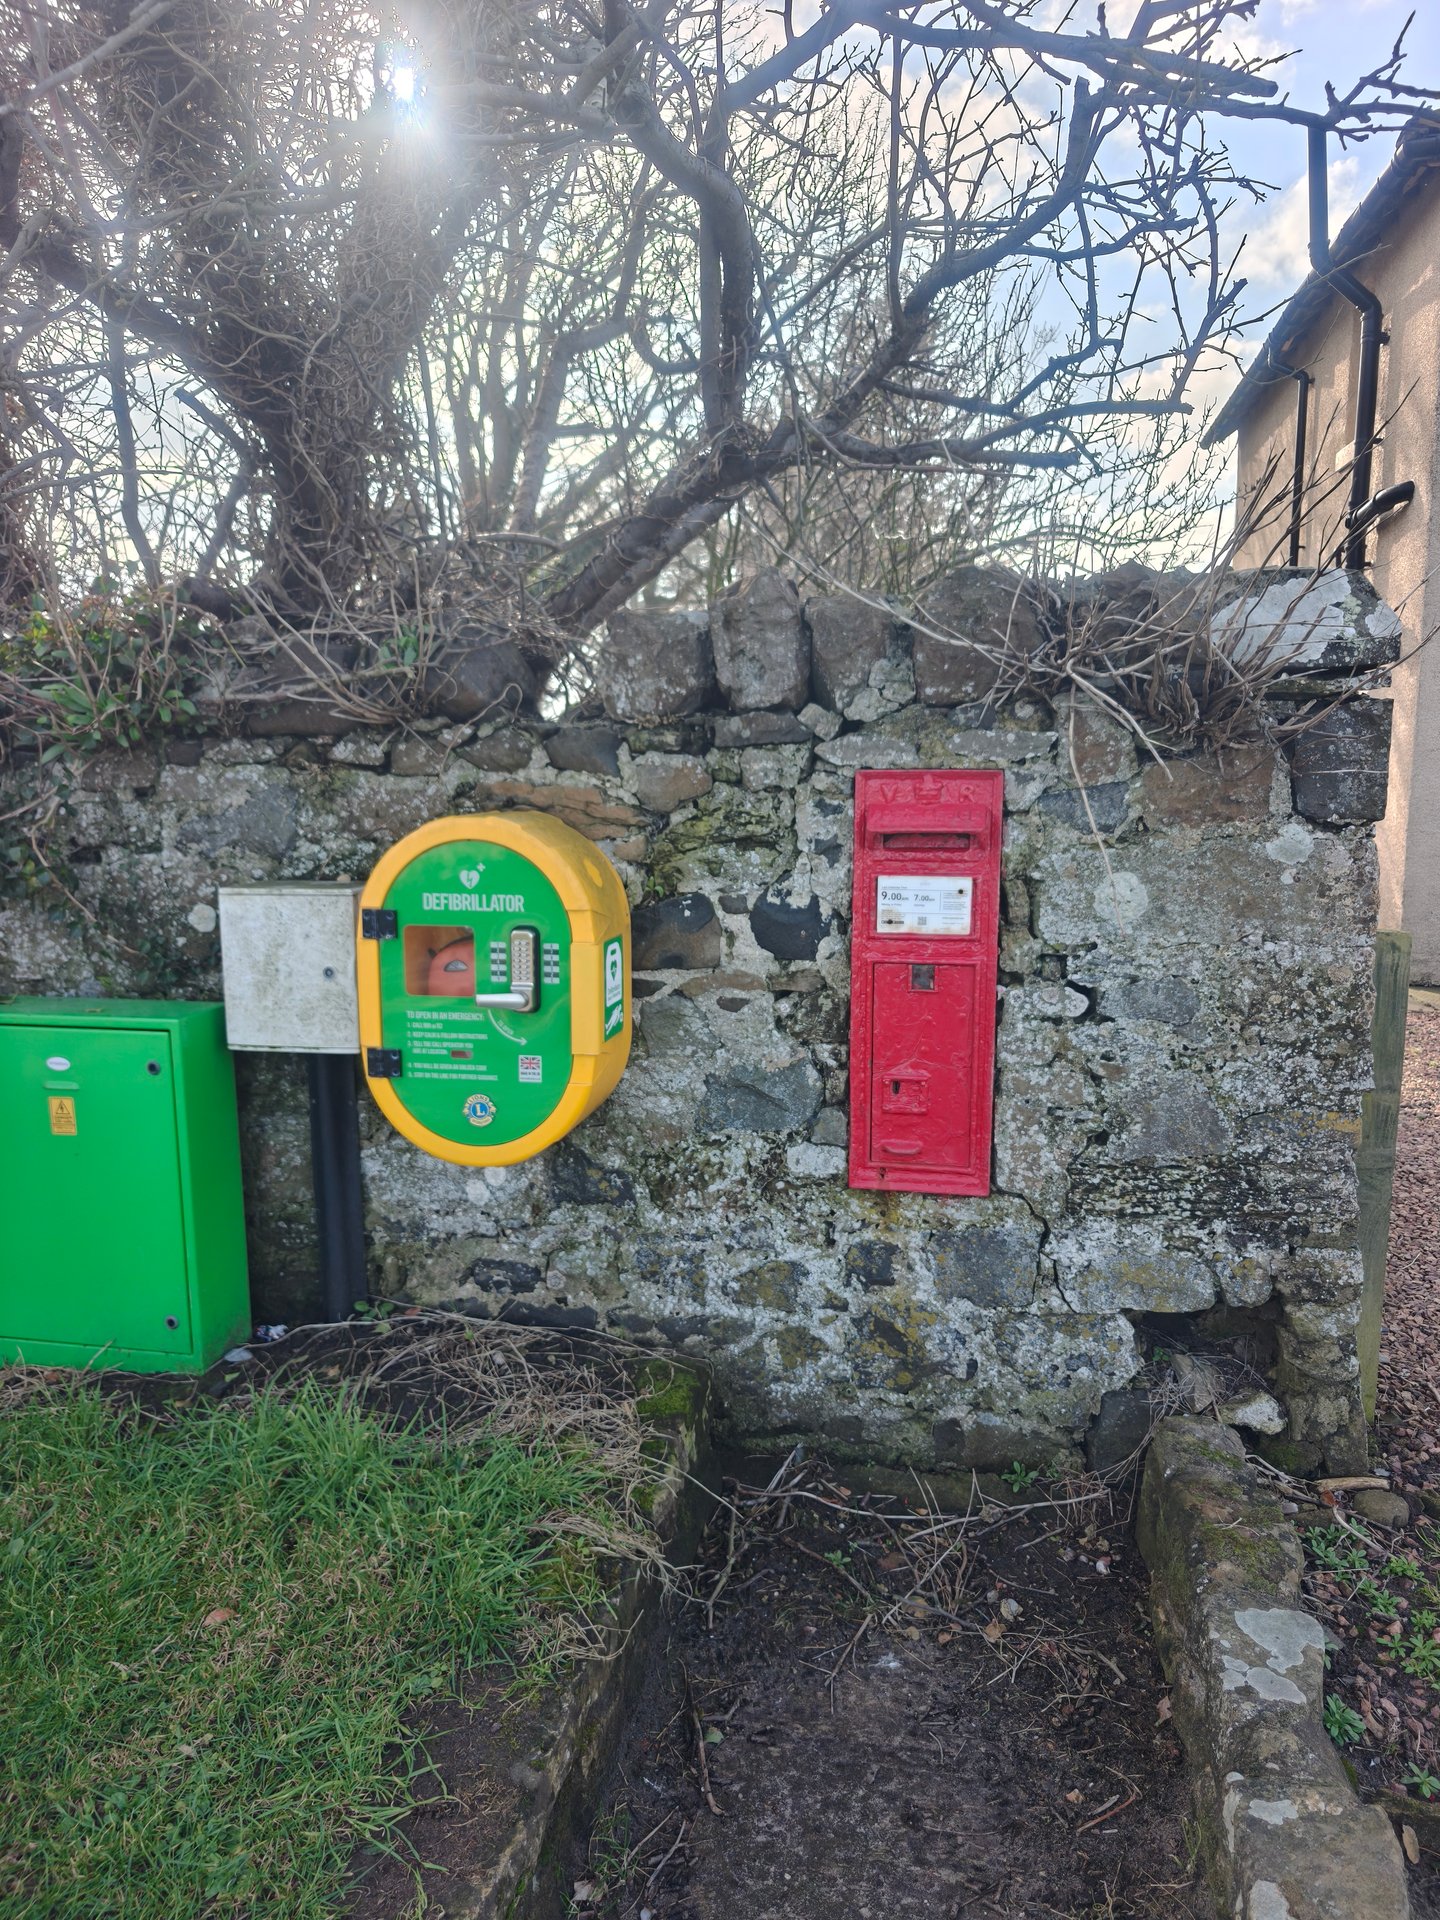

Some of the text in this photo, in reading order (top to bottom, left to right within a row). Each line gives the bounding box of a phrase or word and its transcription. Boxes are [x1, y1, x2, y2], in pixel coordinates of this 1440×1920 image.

[881, 783, 976, 803] V R
[422, 892, 525, 912] DEFIBRILLATOR
[406, 1010, 415, 1019] TO
[415, 1010, 431, 1020] OPEN
[432, 1011, 439, 1020] IN
[439, 1011, 448, 1020] AN
[467, 1094, 489, 1104] LIONS
[476, 1103, 486, 1116] L
